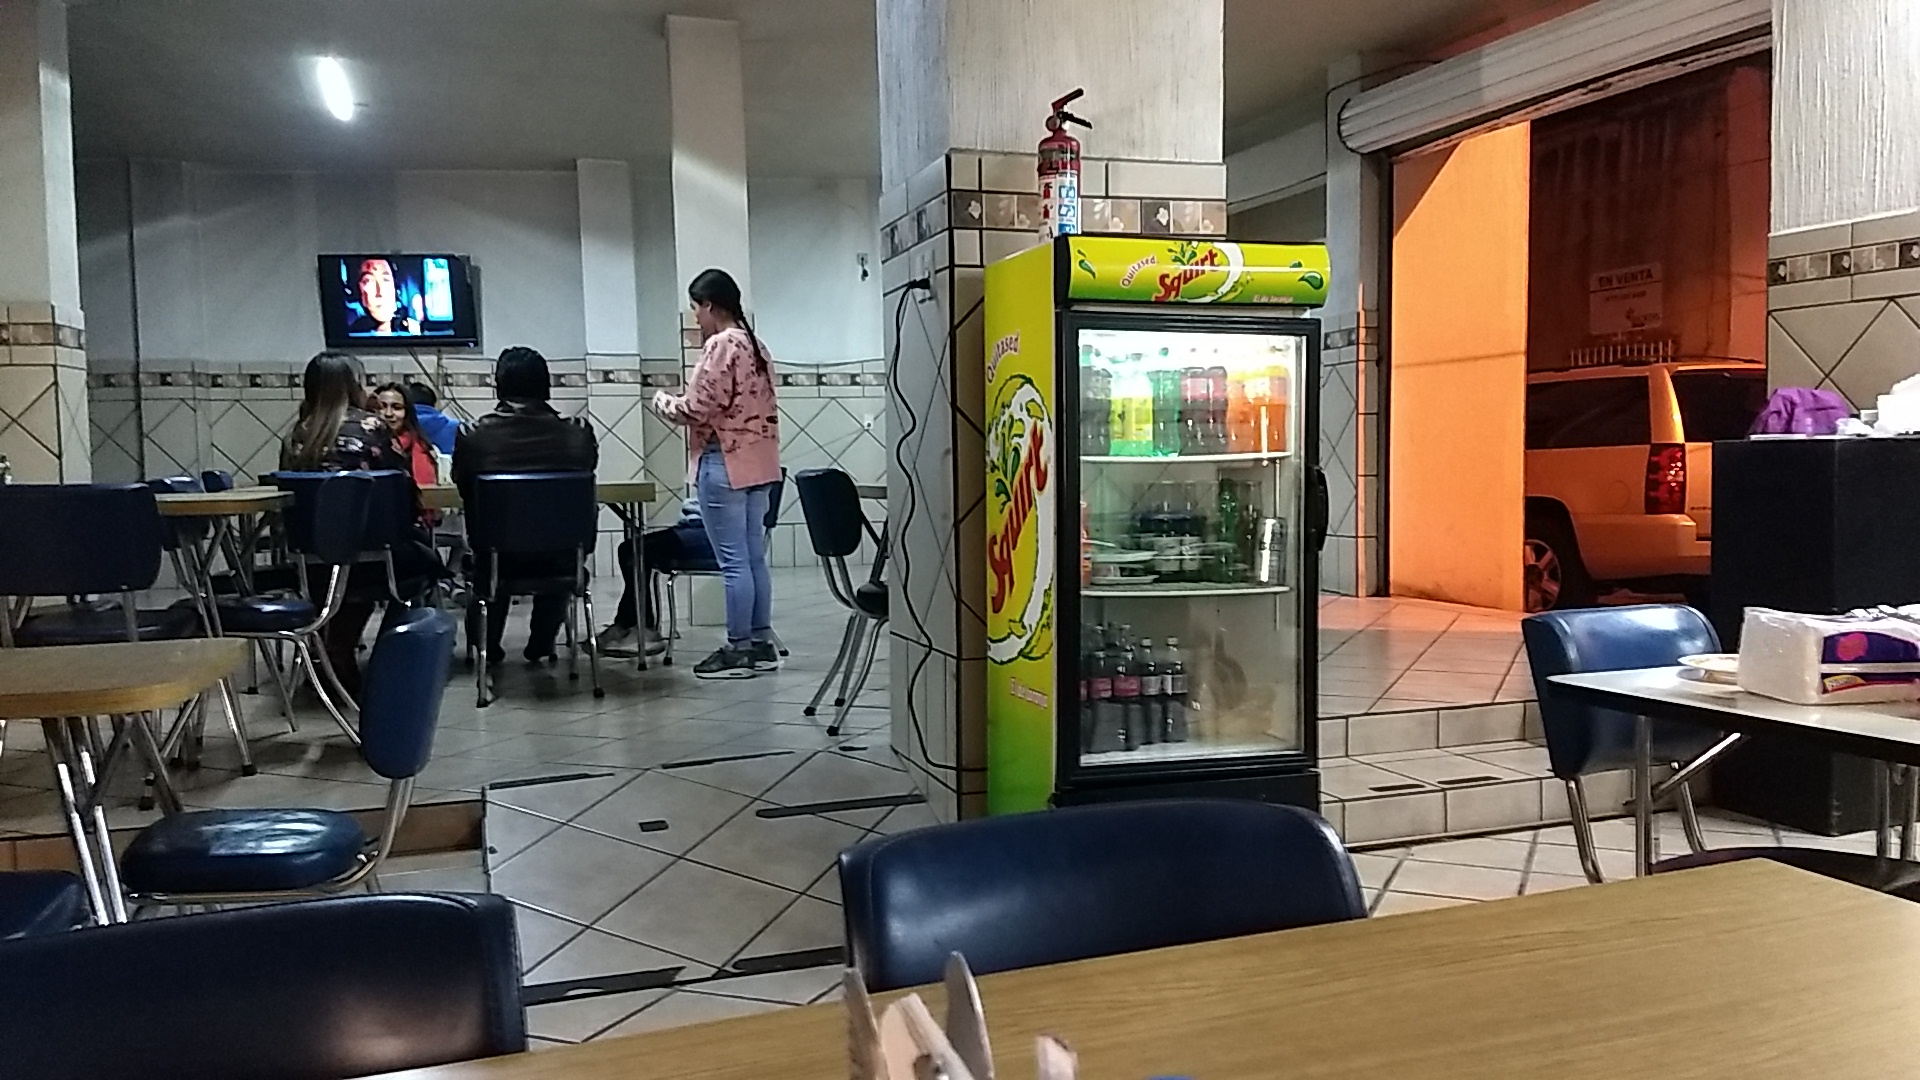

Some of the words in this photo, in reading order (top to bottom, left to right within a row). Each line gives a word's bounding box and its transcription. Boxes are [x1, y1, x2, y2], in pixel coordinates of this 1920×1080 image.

[1121, 255, 1157, 288] Quitased
[1154, 249, 1219, 301] Squirt
[1598, 276, 1613, 287] EN
[1616, 268, 1653, 285] VENTA
[987, 333, 1020, 384] Quitased
[988, 419, 1048, 614] Squirt
